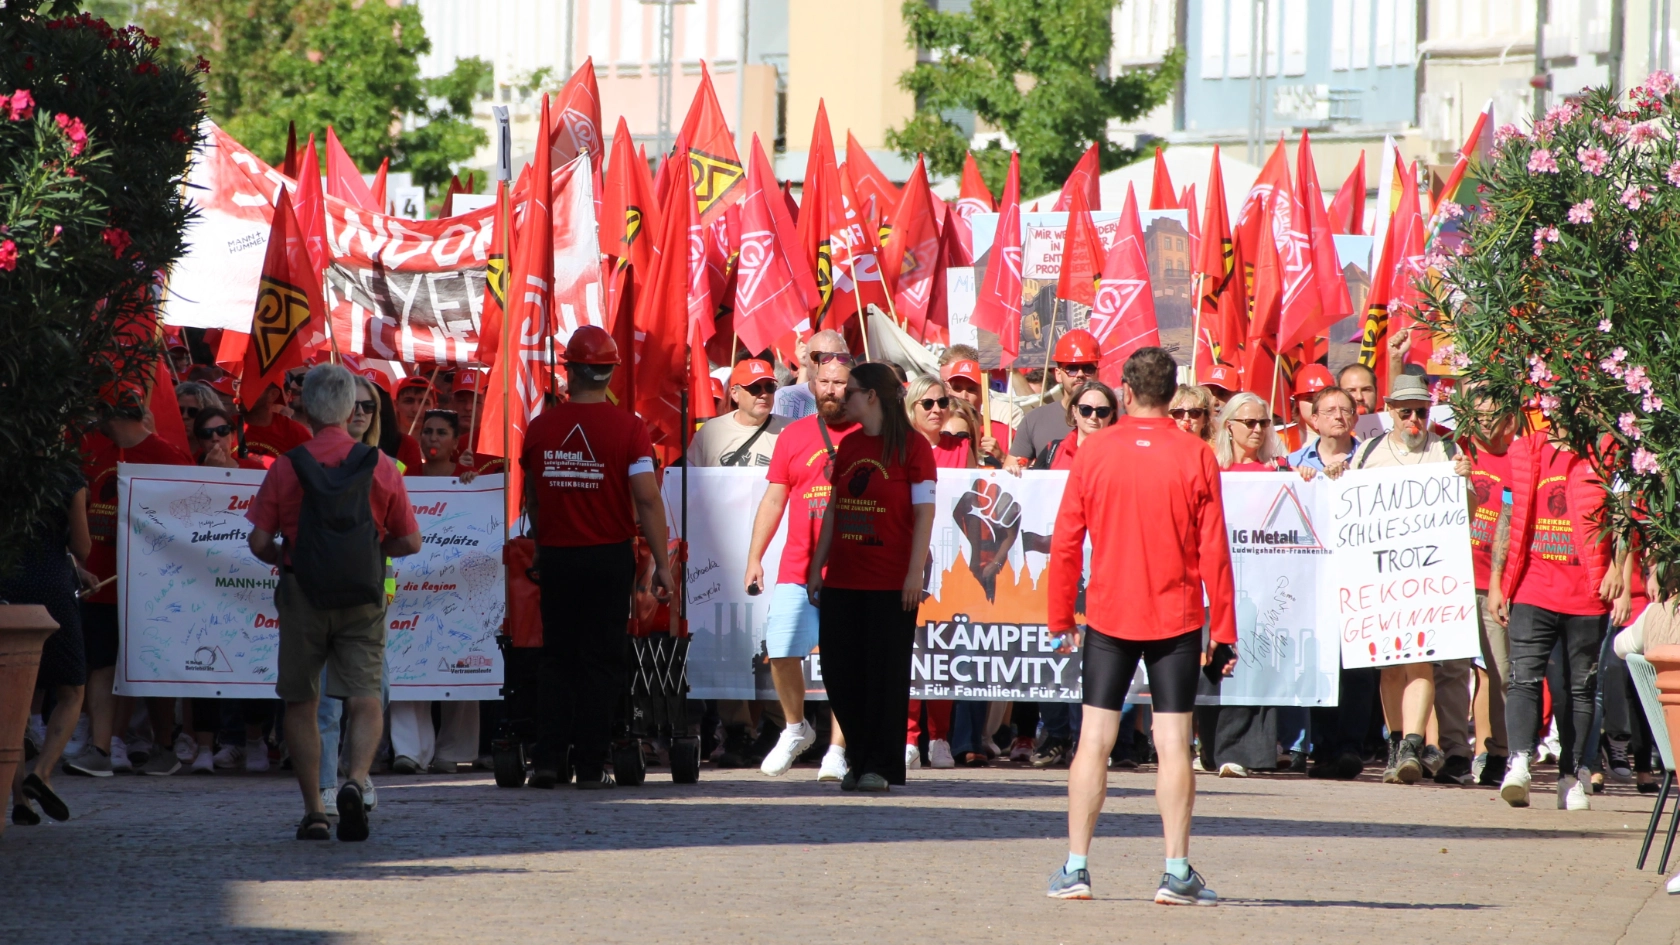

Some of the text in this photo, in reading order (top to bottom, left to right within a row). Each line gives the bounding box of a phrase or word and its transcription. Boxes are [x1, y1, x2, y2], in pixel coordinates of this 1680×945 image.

[543, 450, 583, 460] IG Metall
[191, 528, 249, 543] Zukunfts
[1232, 529, 1299, 545] IG Metall
[1232, 546, 1334, 555] Ludwigshafen-Frankentha
[1542, 553, 1567, 561] SPEYER
[1372, 545, 1445, 573] TROTZ
[403, 581, 419, 591] die
[421, 582, 457, 593] Region
[389, 614, 420, 631] an!
[924, 683, 951, 696] Für
[954, 685, 1026, 698] Familien.
[1029, 685, 1056, 699] Für
